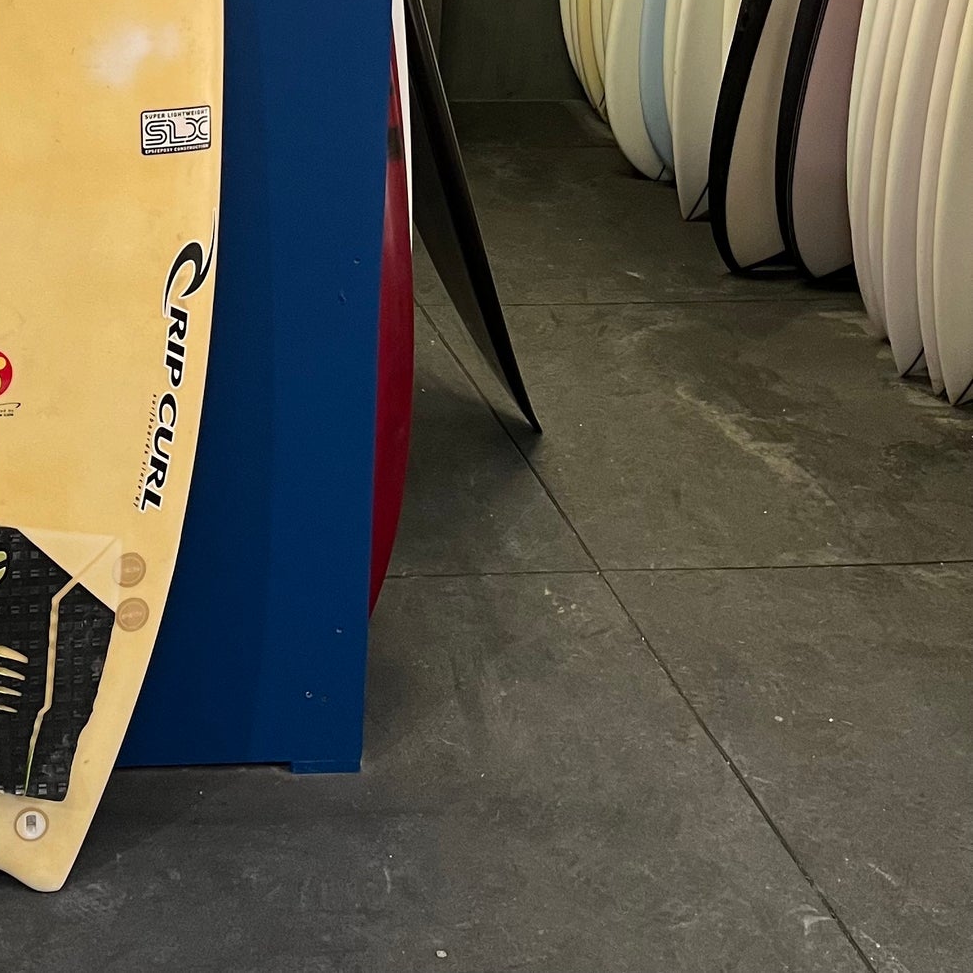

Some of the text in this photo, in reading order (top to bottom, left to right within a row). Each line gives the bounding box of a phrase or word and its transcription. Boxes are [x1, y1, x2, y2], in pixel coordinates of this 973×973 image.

[167, 109, 208, 118] LIGHTWEIGHT
[145, 116, 208, 146] SLX
[173, 144, 209, 152] CONSTRUCTION
[140, 306, 188, 512] RIP CURL
